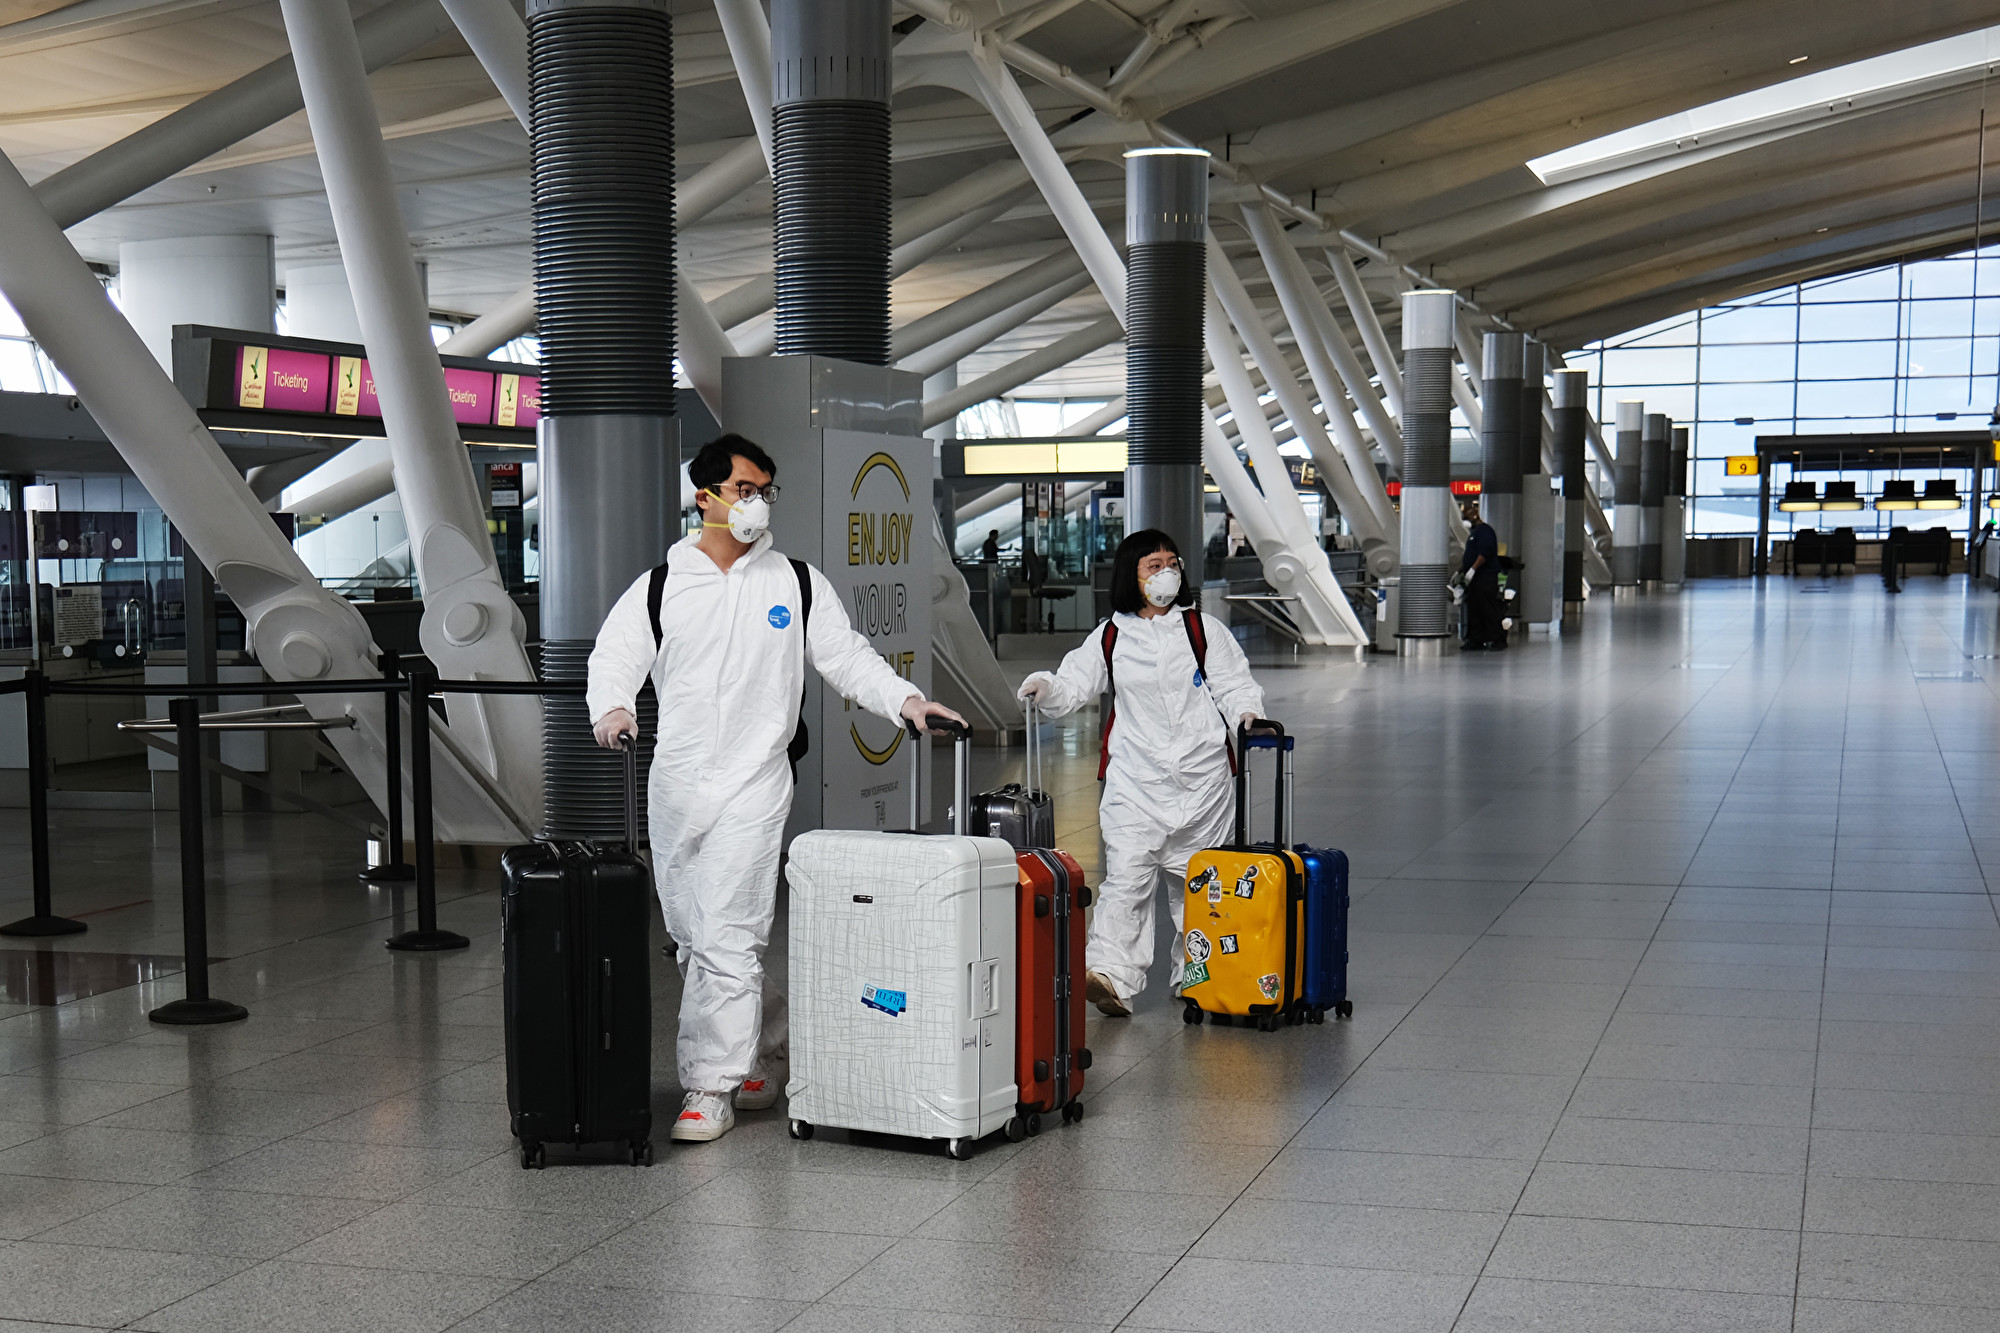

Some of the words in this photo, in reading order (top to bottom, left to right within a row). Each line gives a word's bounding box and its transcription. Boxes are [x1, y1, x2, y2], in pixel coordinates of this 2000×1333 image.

[273, 371, 309, 393] Ticketing
[448, 388, 477, 408] Ticketing
[1740, 463, 1748, 475] 9
[1463, 483, 1481, 492] First
[848, 512, 913, 566] ENJOY
[853, 583, 908, 637] YOUR
